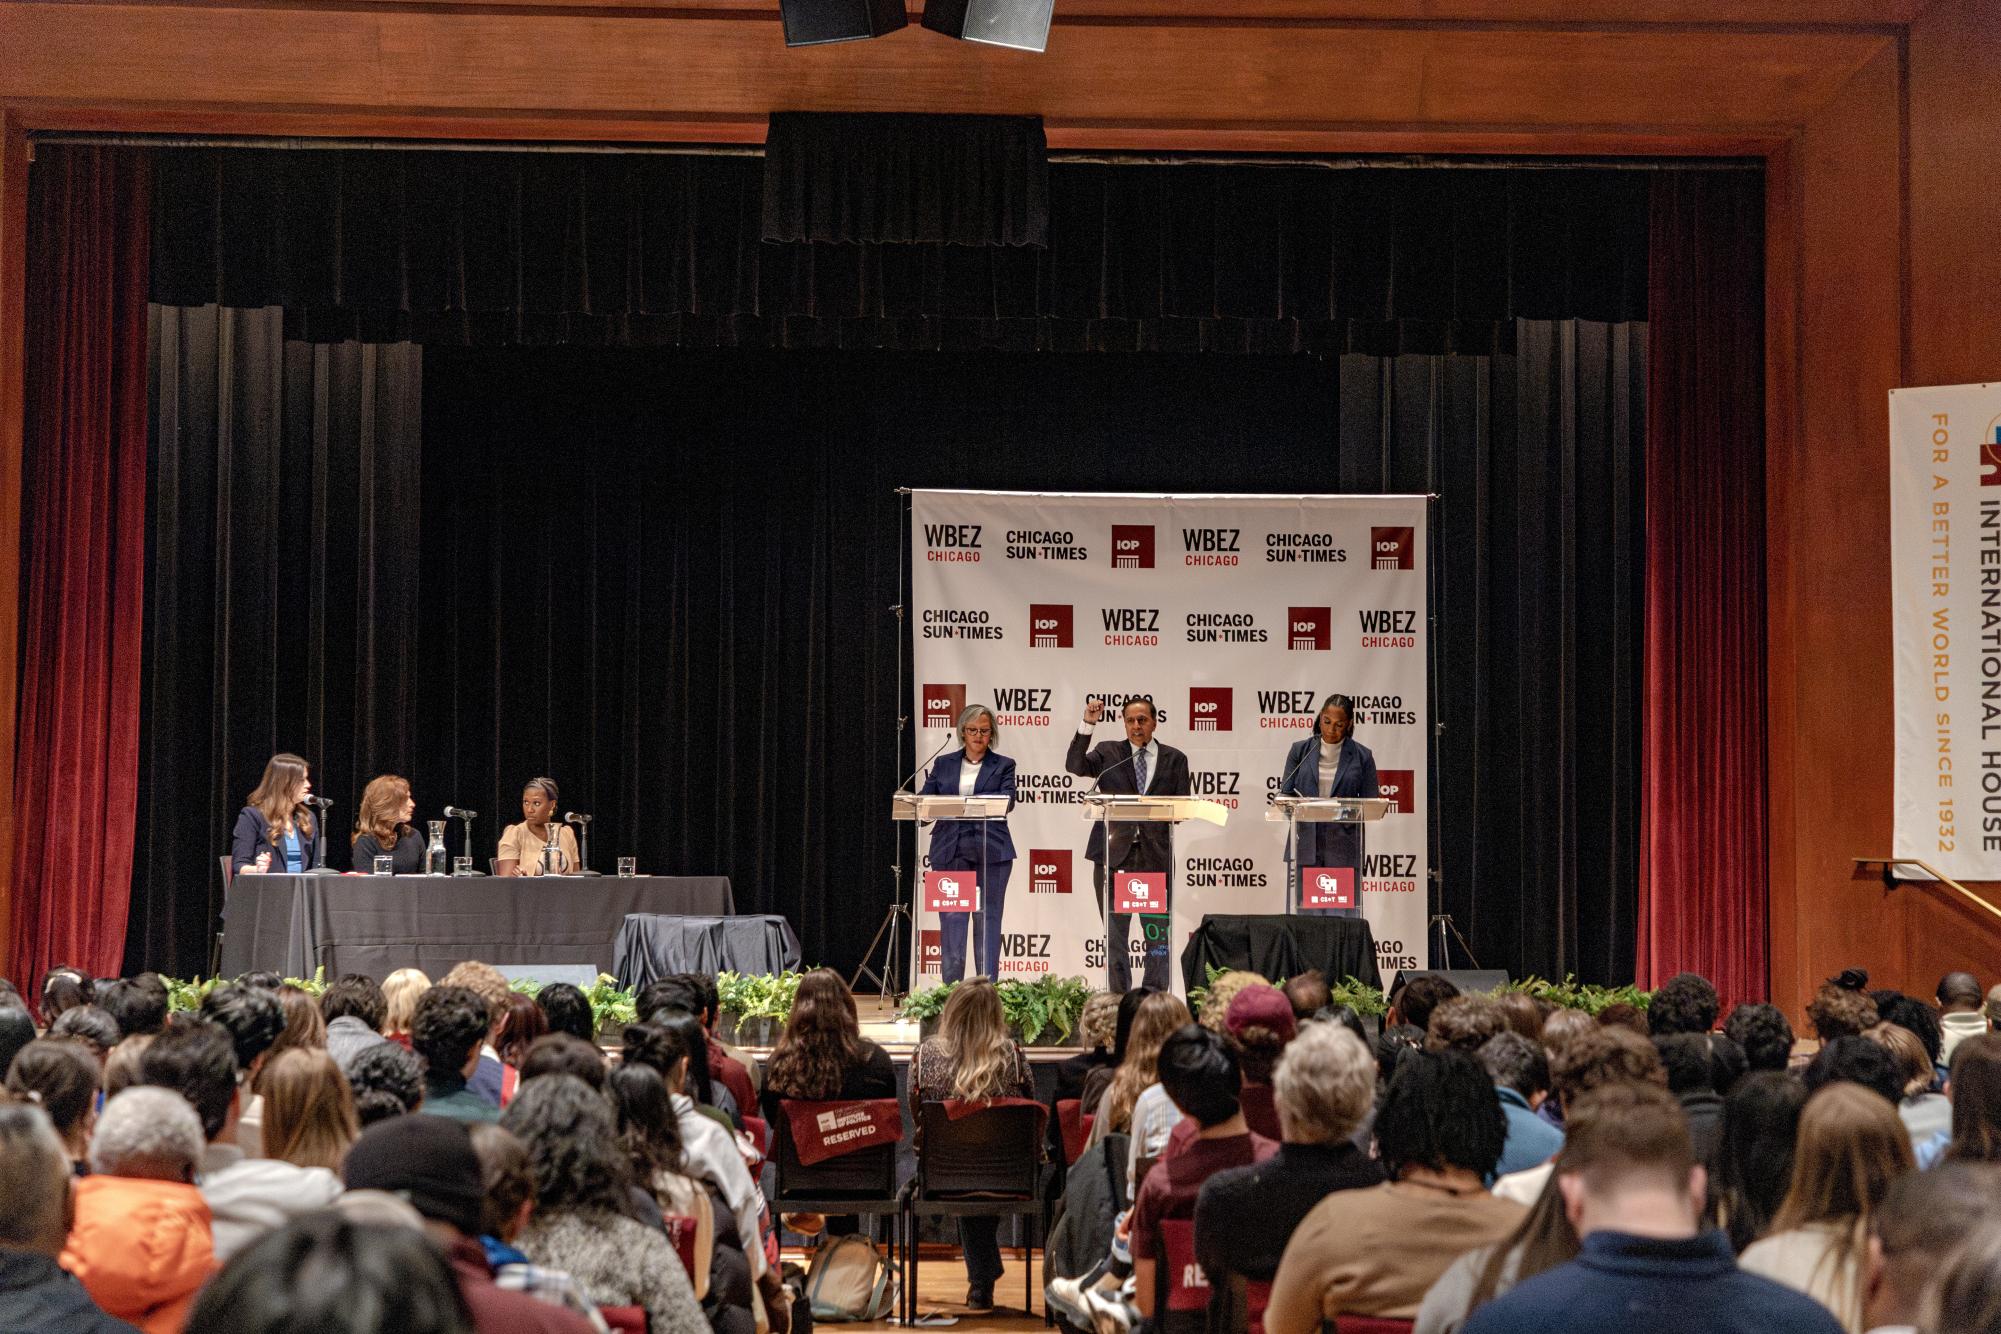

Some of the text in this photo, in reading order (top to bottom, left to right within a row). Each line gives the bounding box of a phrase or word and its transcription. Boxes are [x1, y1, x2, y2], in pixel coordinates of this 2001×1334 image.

[924, 524, 982, 548] WBEZ
[1006, 531, 1074, 544] CHICAGO
[1183, 529, 1240, 552] WBEZ
[1266, 534, 1333, 547] CHICAGO
[1117, 540, 1140, 551] IOP
[1376, 541, 1399, 552] IOP
[928, 550, 980, 562] CHICAGO
[1185, 555, 1239, 566] CHICAGO
[923, 610, 989, 623] CHICAGO
[1102, 609, 1159, 632] WBEZ
[1186, 614, 1254, 627] CHICAGO
[1359, 610, 1416, 634] WBEZ
[1035, 619, 1058, 630] IOP
[1293, 622, 1316, 632] IOP
[1932, 412, 1955, 853] FOR A BETTER WORLD SINCE 1932
[1105, 635, 1158, 646] CHICAGO
[1362, 637, 1415, 648] CHICAGO
[1980, 500, 2001, 851] INTERNATIONAL HOUSE
[928, 699, 951, 710] IOP
[993, 688, 1052, 712] WBEZ
[1258, 691, 1315, 714] WBEZ
[1195, 702, 1217, 713] IOP
[997, 715, 1050, 727] CHICAGO
[1260, 717, 1314, 729] CHICAGO
[1016, 775, 1072, 788] HICAGO
[1378, 785, 1399, 796] OP
[1034, 864, 1057, 875] IOP
[1186, 858, 1254, 871] CHICAGO
[1362, 855, 1416, 878] WBEZ
[1362, 881, 1415, 892] CHICAGO
[925, 945, 942, 956] IO
[823, 1125, 876, 1146] RESERVED
